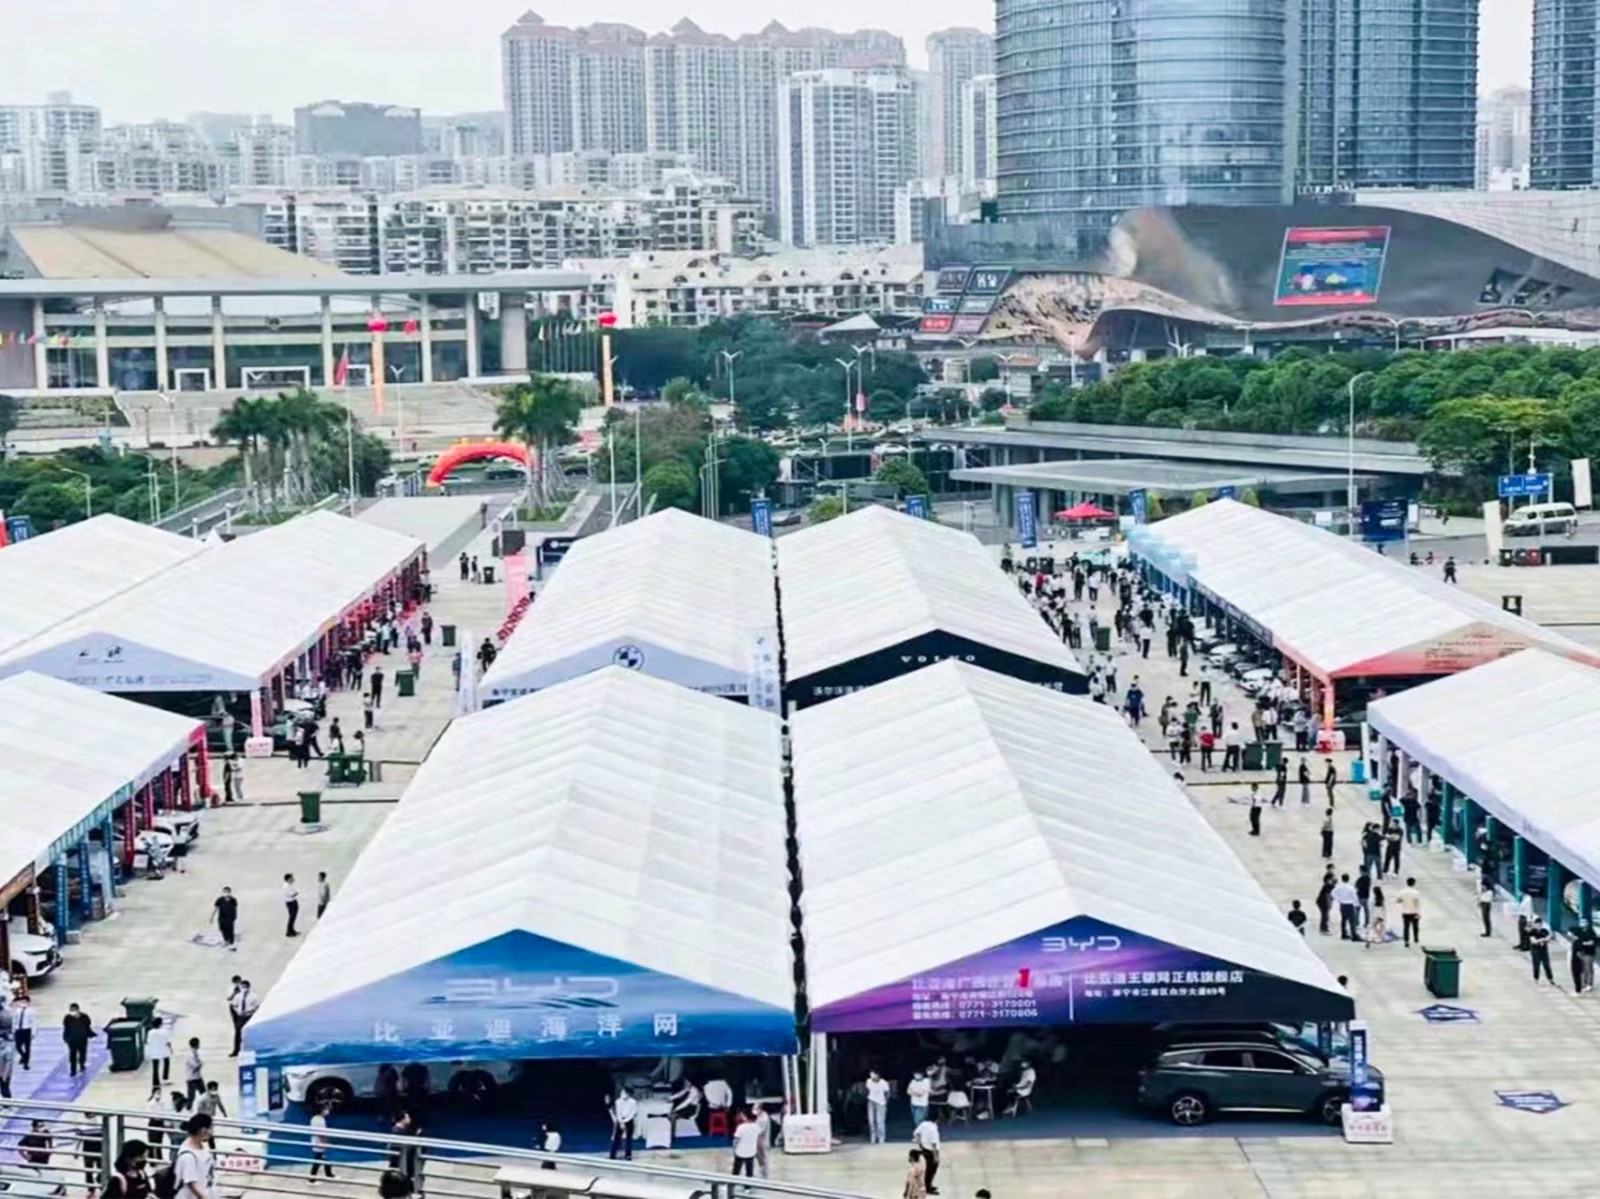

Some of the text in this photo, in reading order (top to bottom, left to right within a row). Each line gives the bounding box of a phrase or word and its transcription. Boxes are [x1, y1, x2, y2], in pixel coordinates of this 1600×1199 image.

[1041, 936, 1121, 952] BYD
[444, 976, 619, 1001] BYD
[373, 1012, 679, 1042] 比亚迪海洋网
